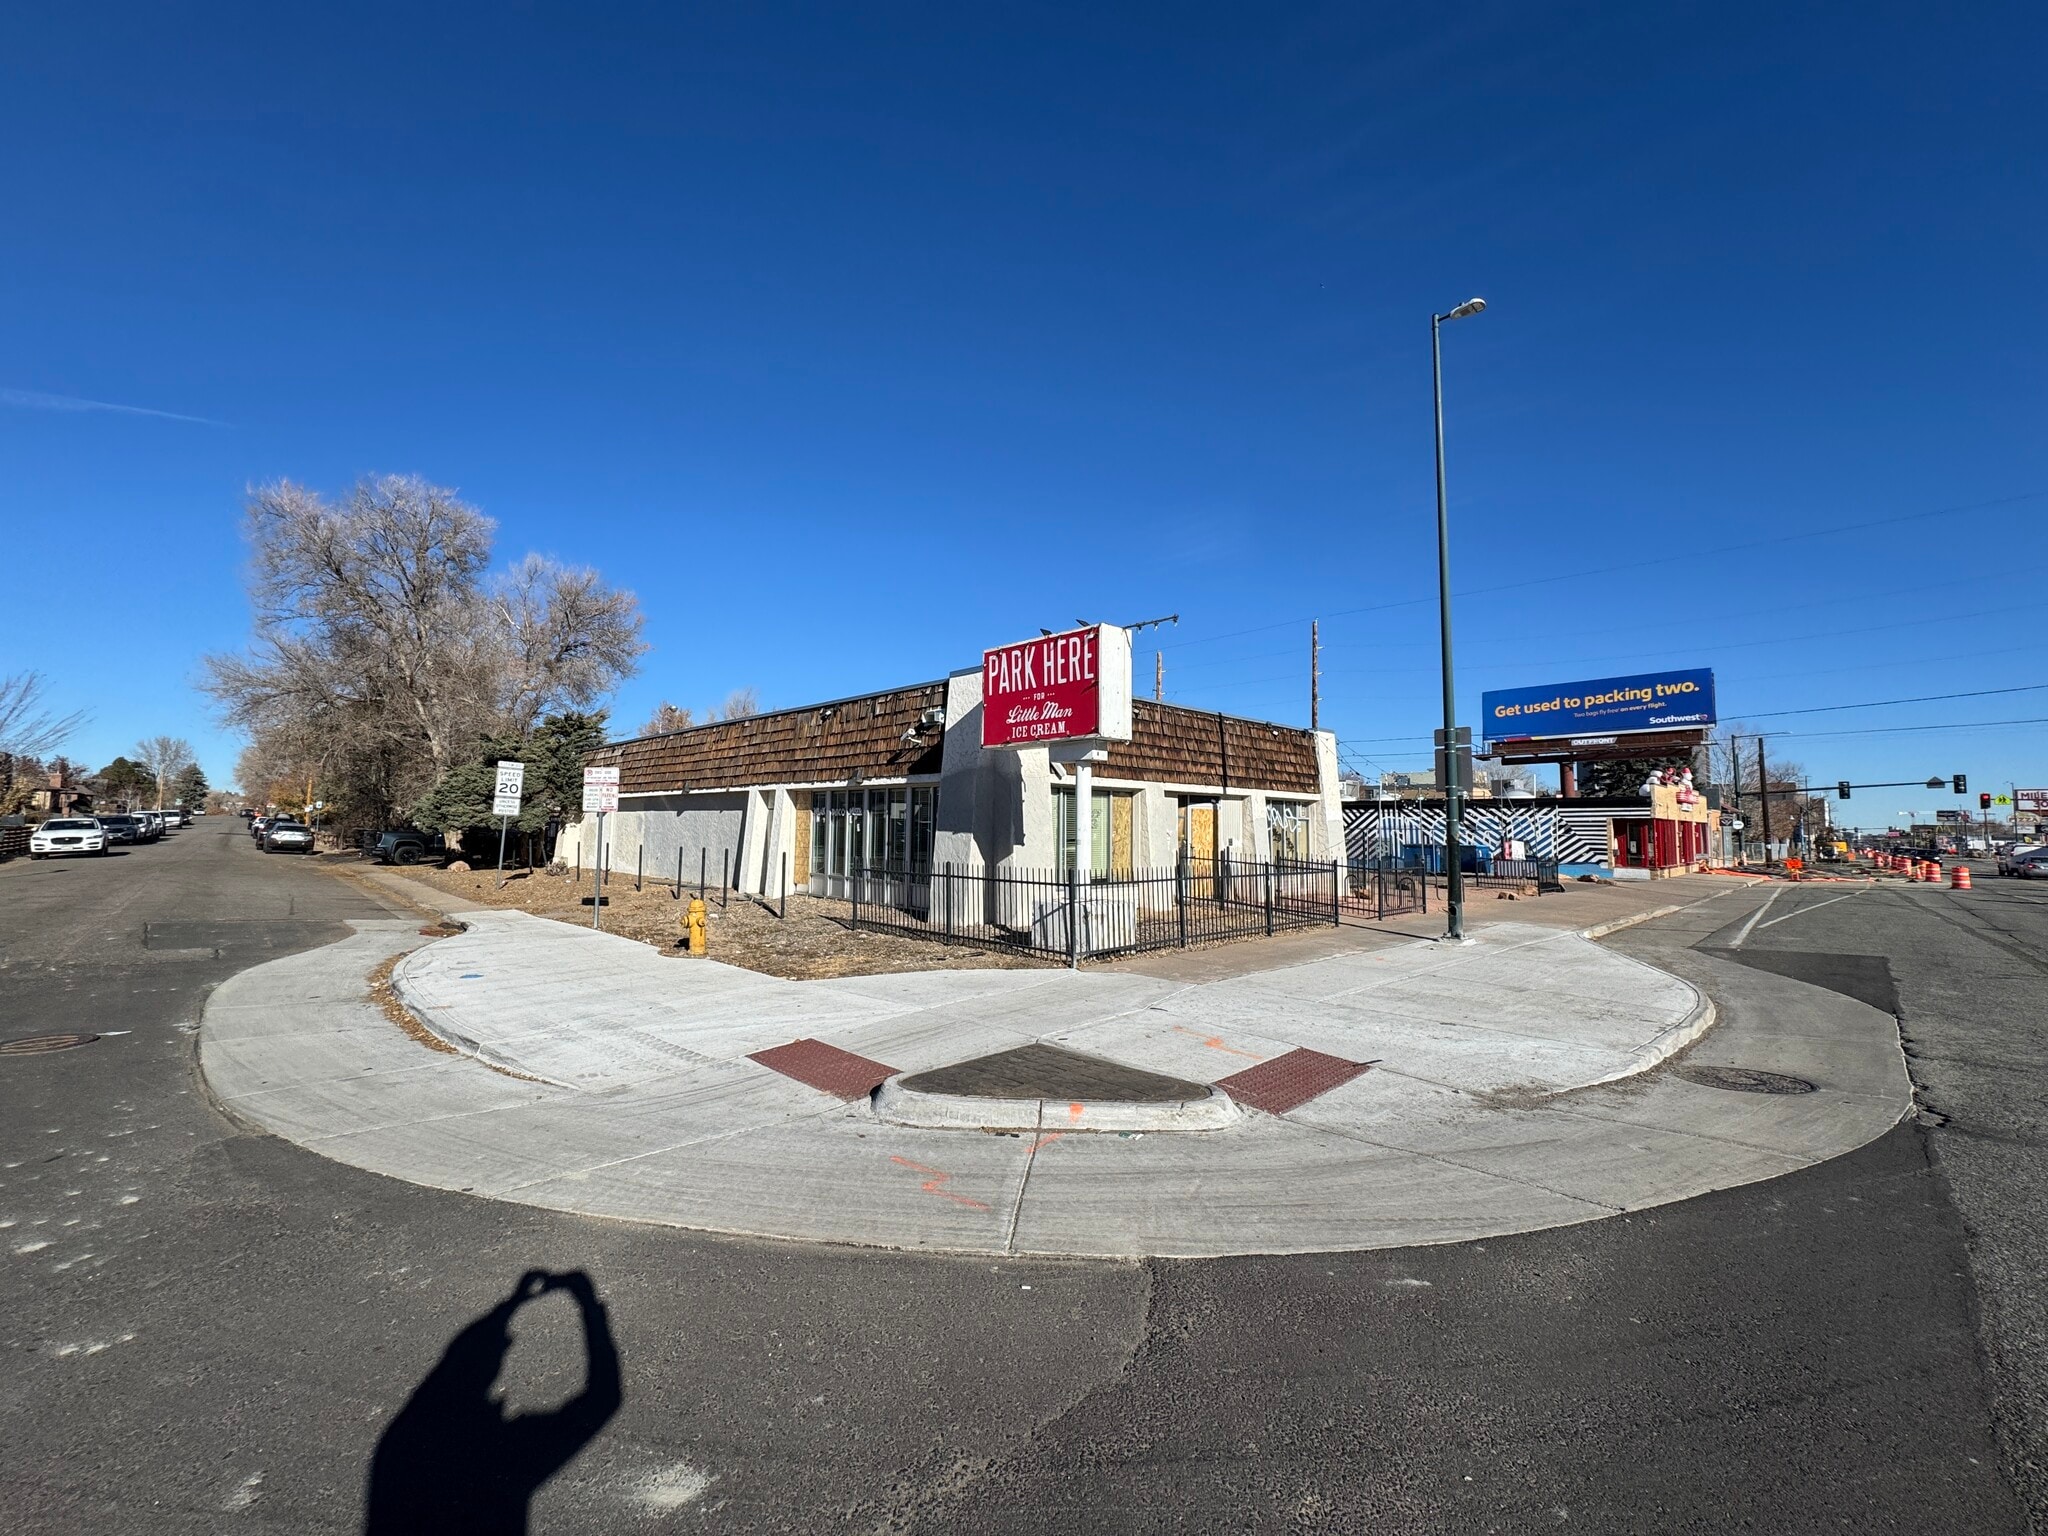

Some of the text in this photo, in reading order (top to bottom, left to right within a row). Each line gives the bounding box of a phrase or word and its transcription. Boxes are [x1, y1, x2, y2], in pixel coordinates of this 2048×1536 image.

[988, 633, 1095, 696] PARK HERE
[1033, 692, 1045, 700] FOR
[1494, 681, 1700, 718] Get used to packing two.
[1005, 701, 1073, 724] Little Man
[1586, 709, 1599, 718] bags
[1647, 701, 1667, 709] flight.
[1649, 713, 1701, 725] Southwest
[1011, 721, 1066, 739] ICE CREAM
[498, 782, 519, 794] 20
